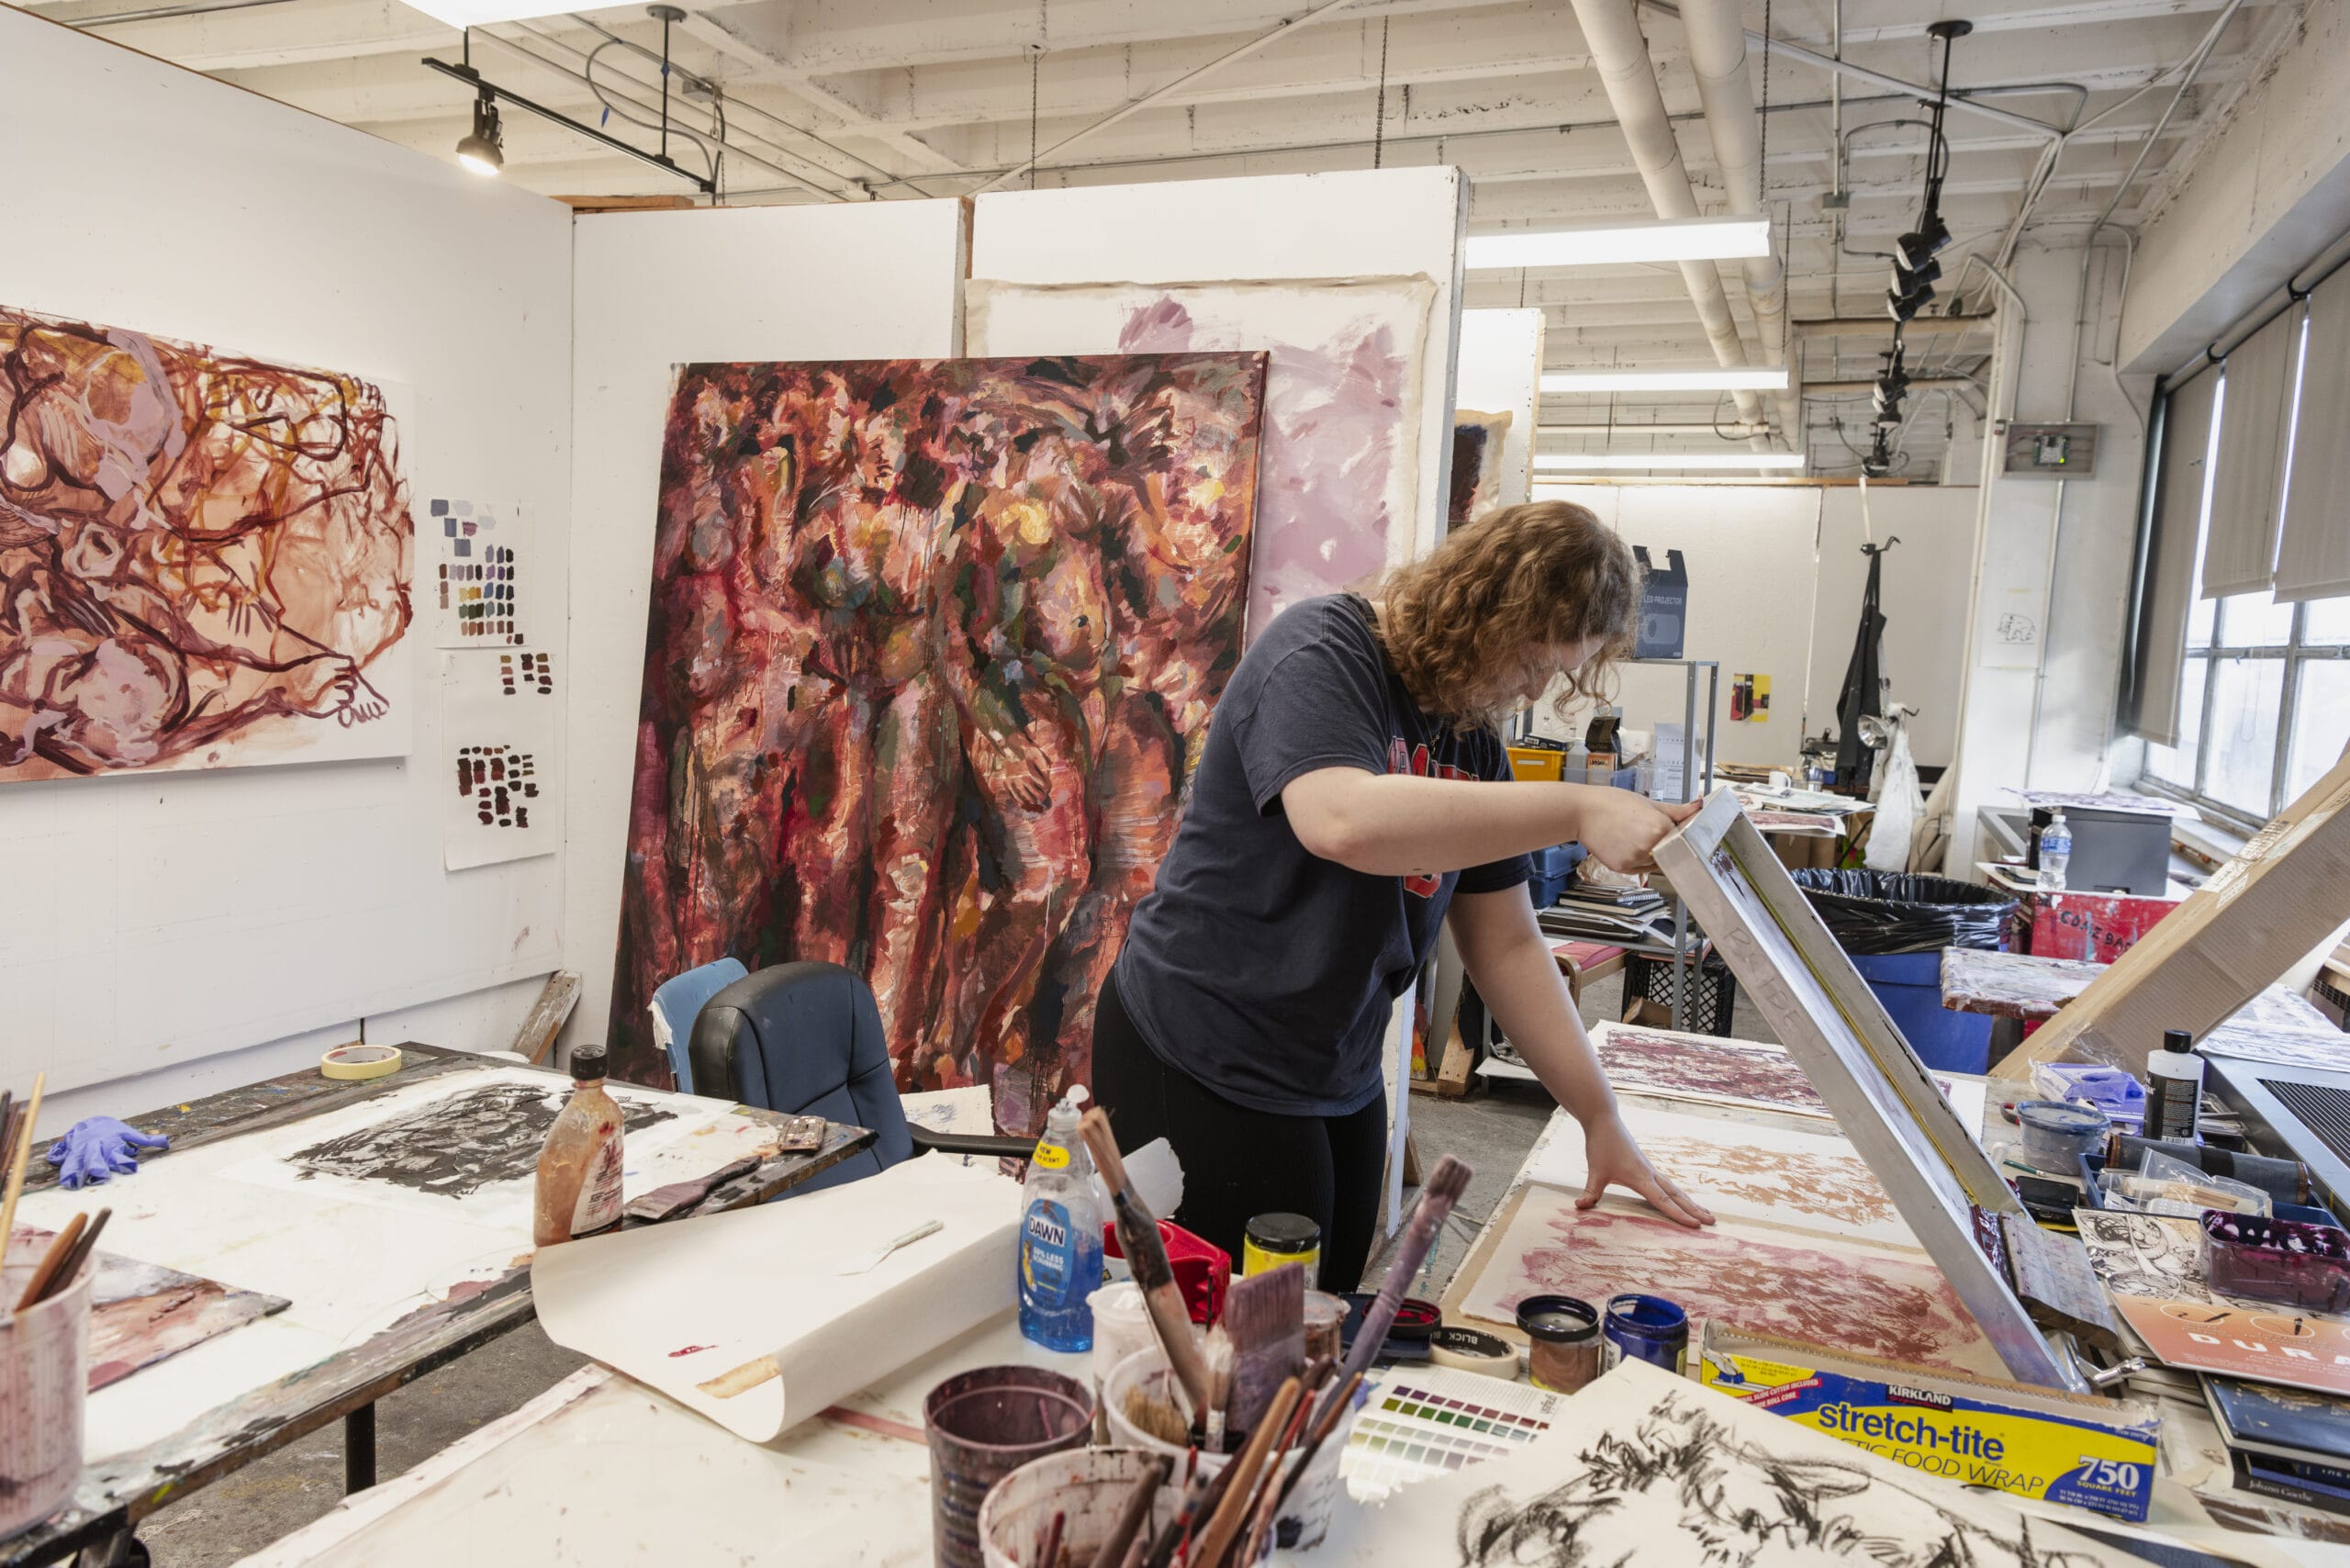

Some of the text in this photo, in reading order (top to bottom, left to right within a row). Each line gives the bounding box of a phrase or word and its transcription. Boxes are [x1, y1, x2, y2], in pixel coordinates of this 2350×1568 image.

[2060, 911, 2102, 940] COME
[1029, 1216, 1064, 1245] DAWN
[1449, 1331, 1478, 1345] BLICK
[1769, 1384, 1790, 1395] CUTTER
[1790, 1379, 1818, 1389] INCLUDED
[1888, 1385, 1952, 1406] KIRKLAND
[1766, 1396, 1781, 1406] ROLL
[1818, 1404, 2005, 1462] stretch-tite
[1891, 1448, 2044, 1493] FOOD WRAP
[2078, 1454, 2140, 1490] 750
[2076, 1480, 2137, 1498] SQUARE FEET
